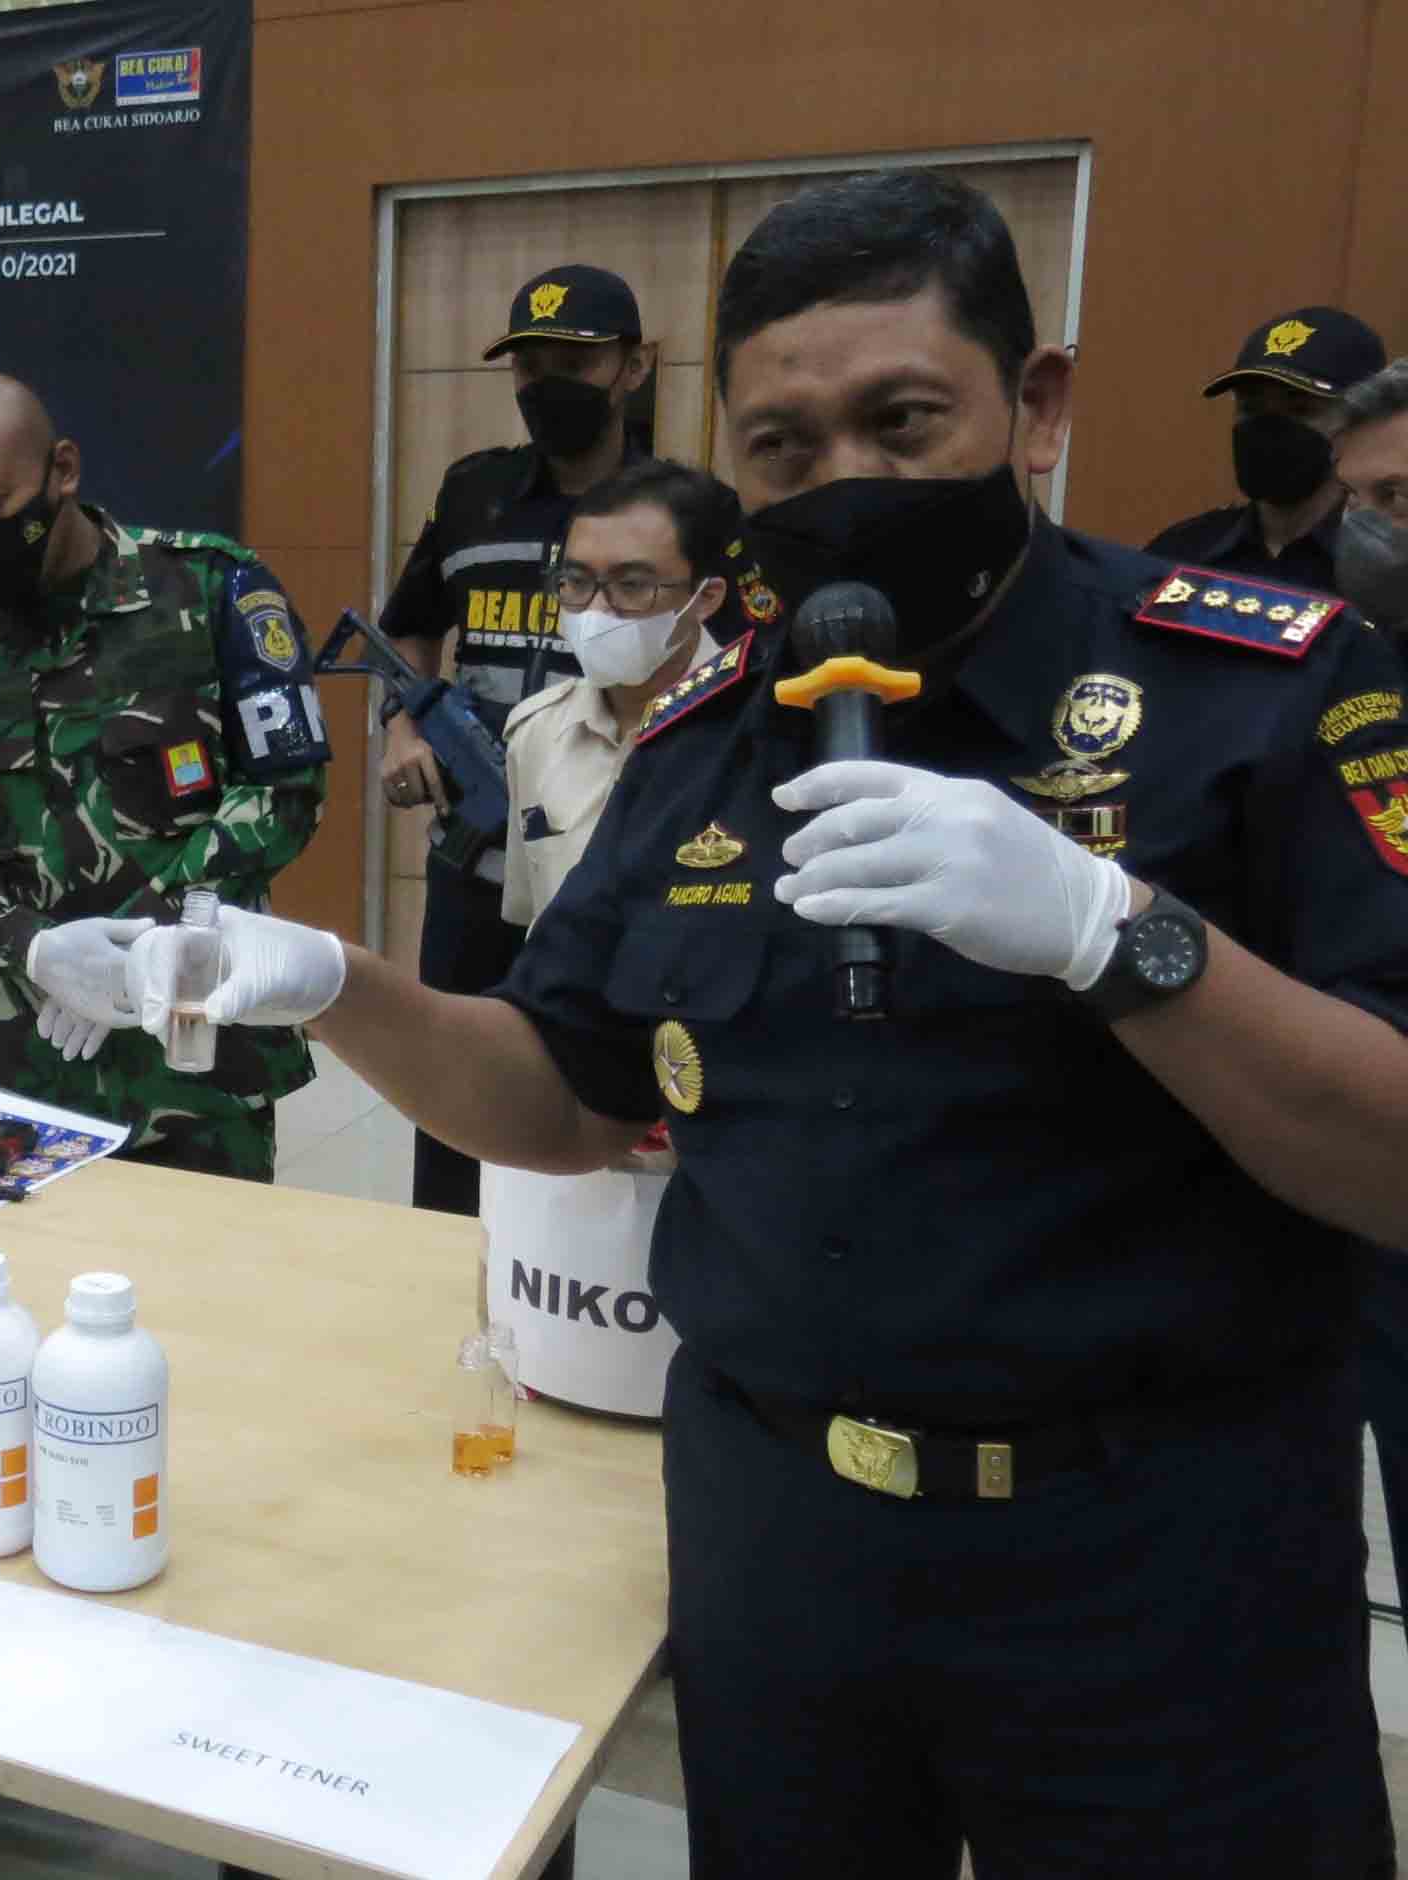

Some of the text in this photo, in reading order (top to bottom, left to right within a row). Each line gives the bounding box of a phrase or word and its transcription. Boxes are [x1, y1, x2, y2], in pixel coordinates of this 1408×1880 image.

[53, 109, 201, 133] BEA CUKAI SIDOARJO
[467, 589, 522, 632] BEA
[711, 882, 752, 904] AGUNG
[511, 1258, 661, 1335] NIKO
[172, 1729, 370, 1797] SWEET TENER
